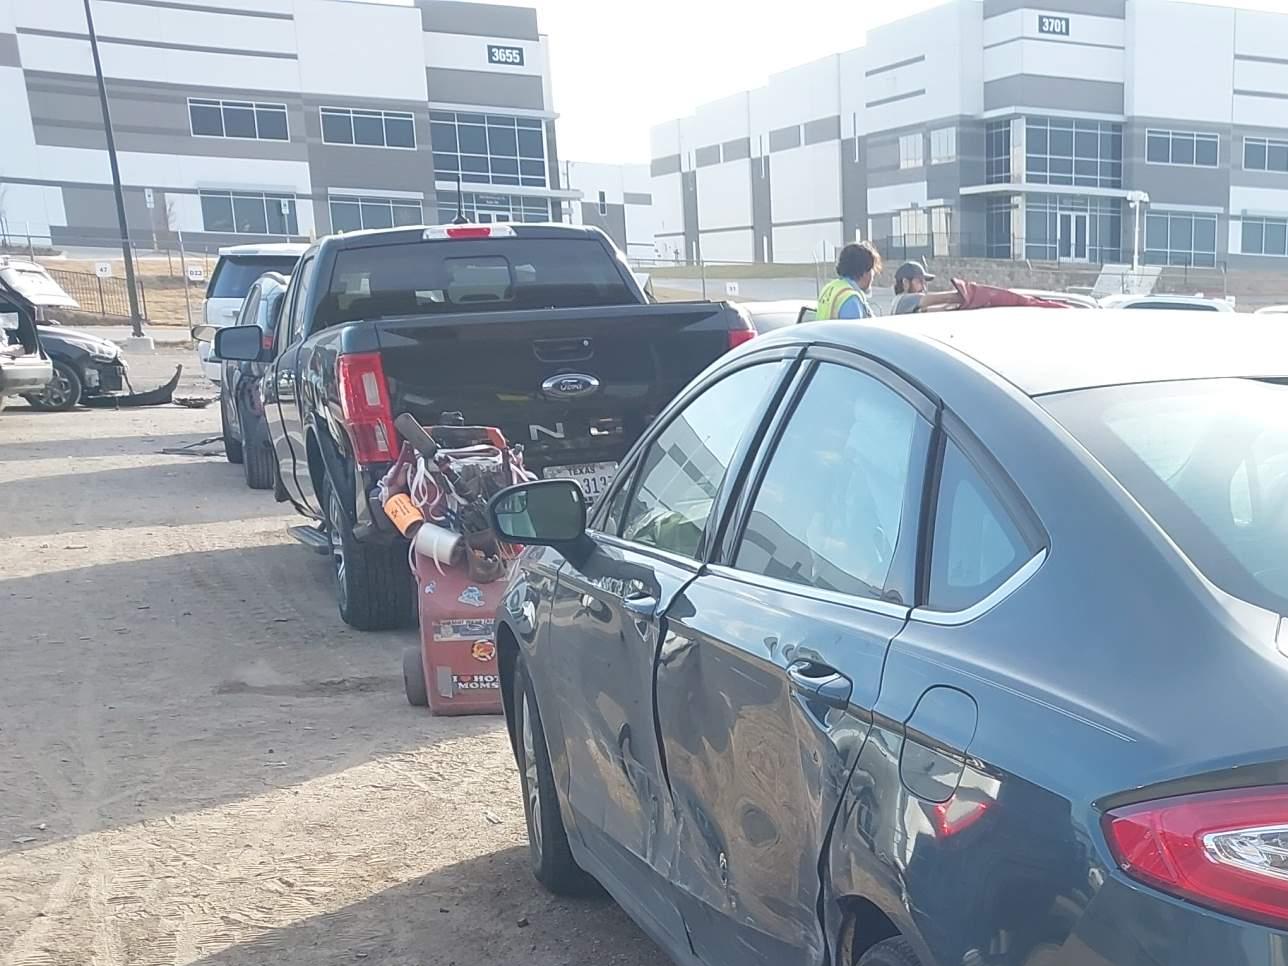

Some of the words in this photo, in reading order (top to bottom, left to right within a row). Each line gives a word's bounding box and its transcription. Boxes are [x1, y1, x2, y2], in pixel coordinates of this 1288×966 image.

[1042, 17, 1066, 33] 3701
[491, 47, 521, 63] 3655
[567, 464, 597, 477] TEXAS
